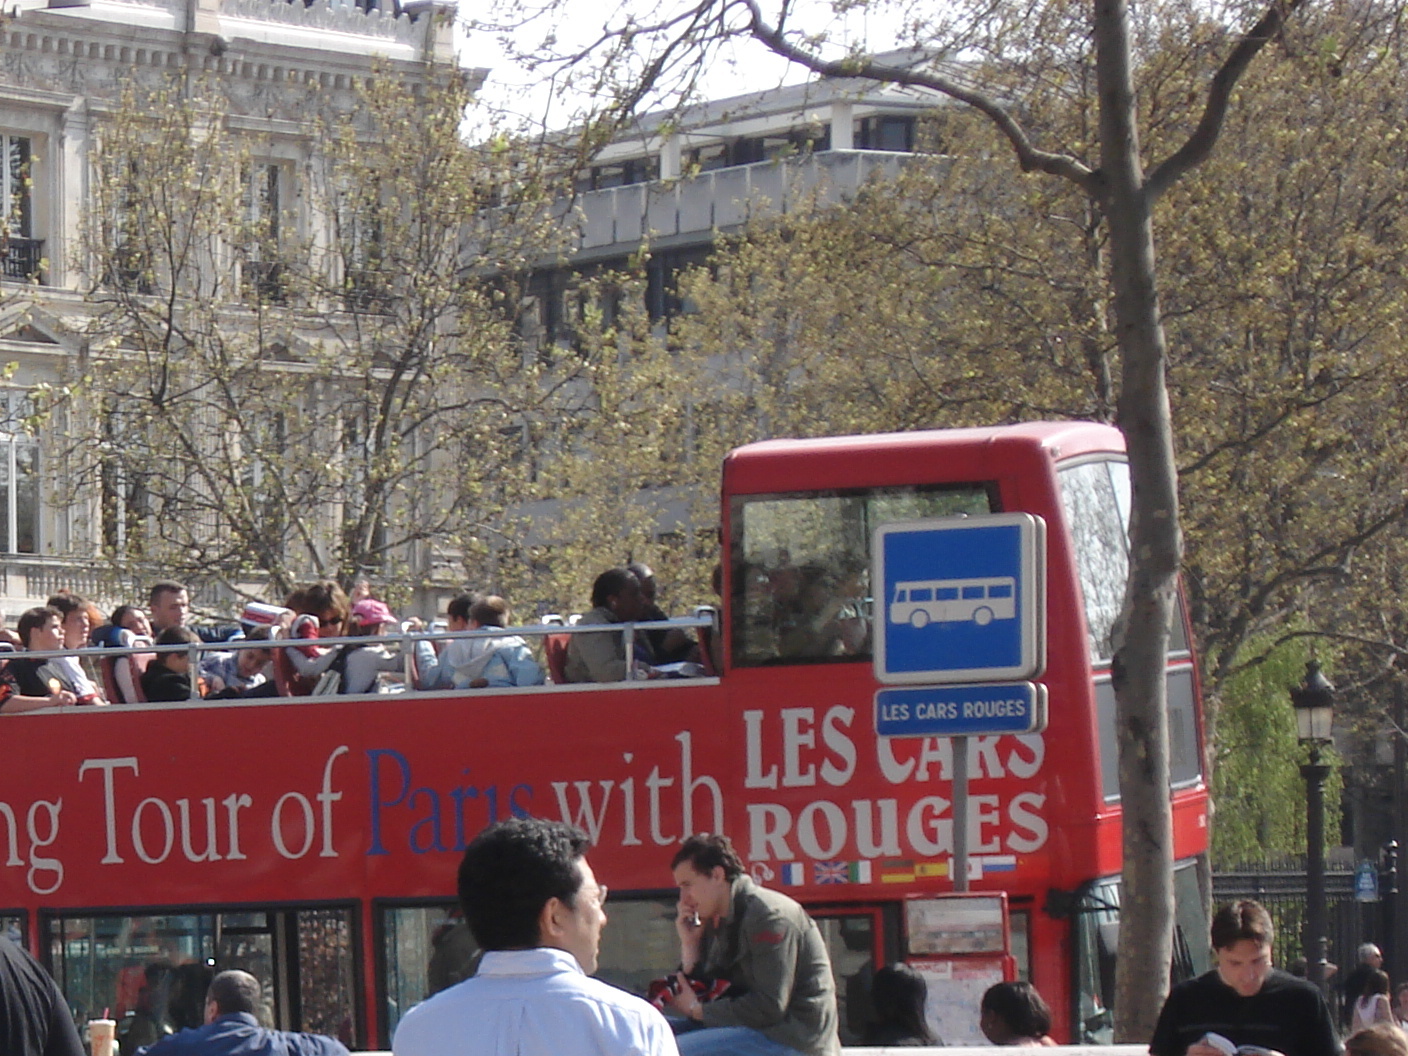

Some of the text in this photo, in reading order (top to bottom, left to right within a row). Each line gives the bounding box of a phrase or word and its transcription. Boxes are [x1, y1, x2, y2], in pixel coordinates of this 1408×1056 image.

[744, 705, 857, 789] LES
[882, 699, 1026, 721] LES CARS ROUGES
[78, 757, 253, 865] Tour
[271, 745, 349, 860] of
[550, 730, 724, 847] with
[746, 792, 1050, 861] ROUGES
